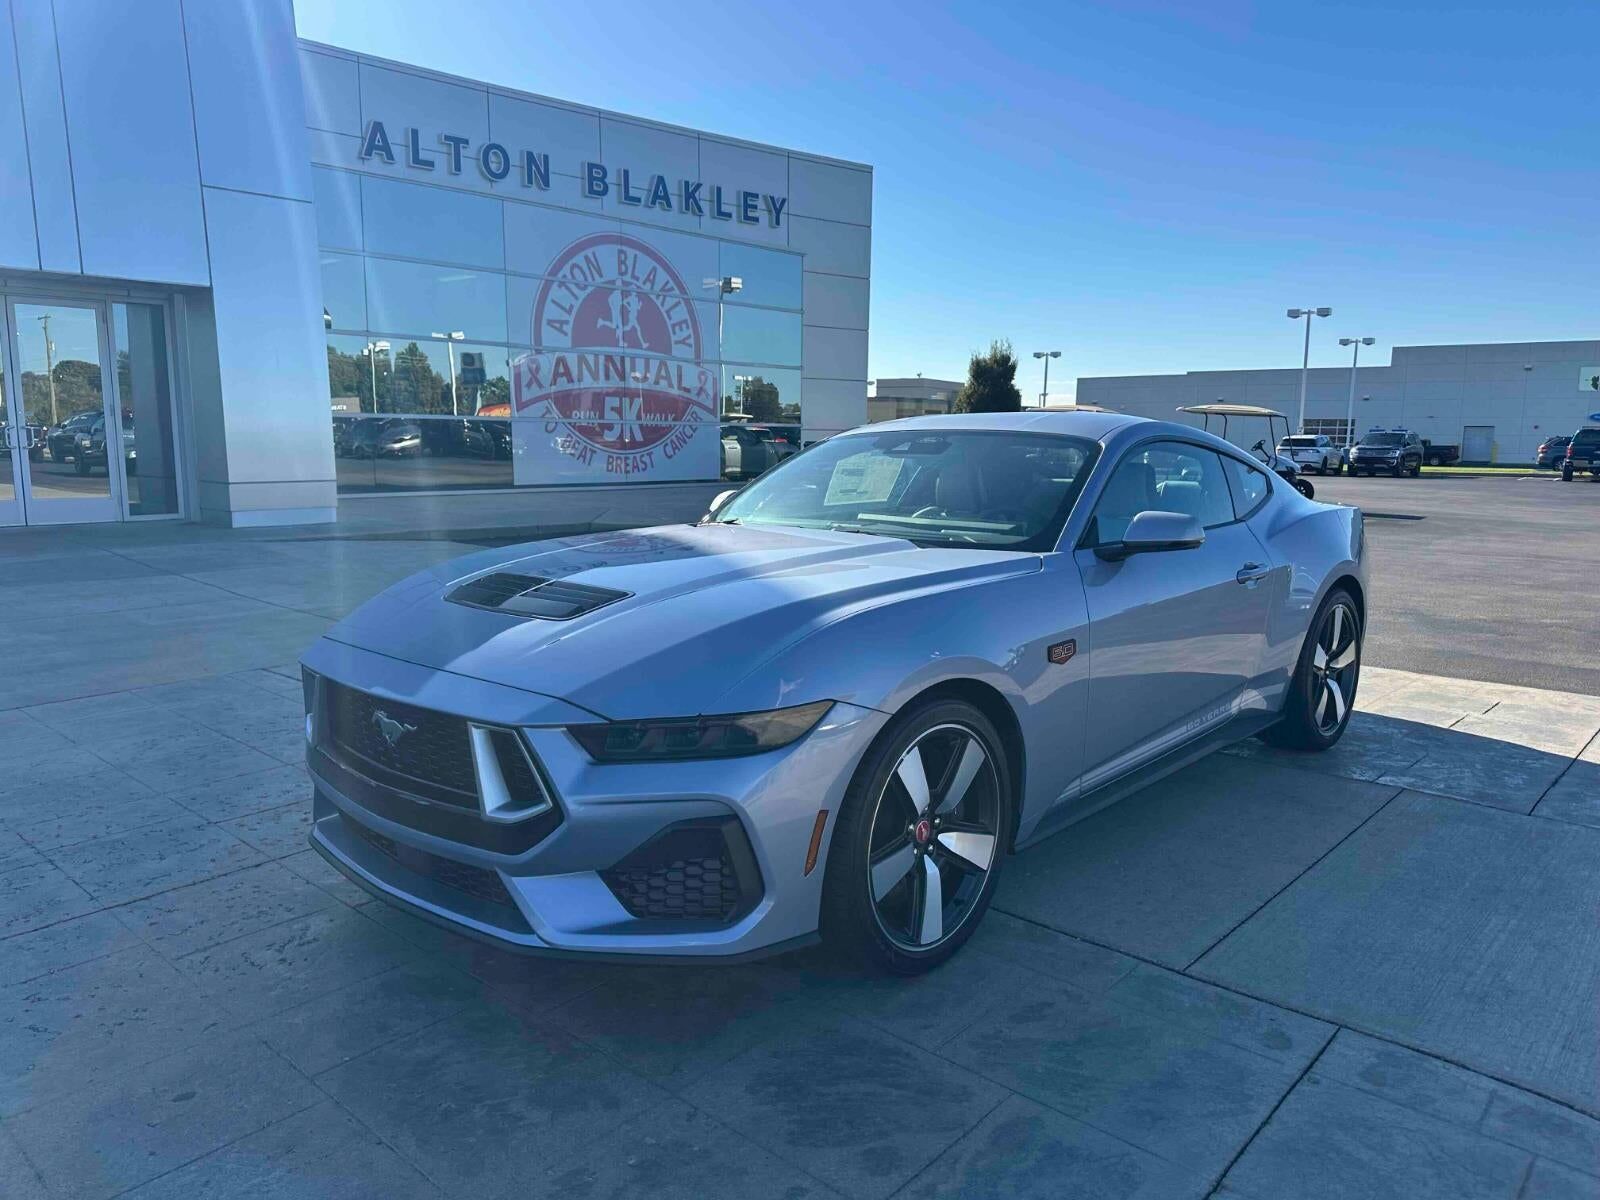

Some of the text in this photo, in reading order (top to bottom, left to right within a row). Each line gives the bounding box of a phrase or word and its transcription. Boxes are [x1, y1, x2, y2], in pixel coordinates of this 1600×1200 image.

[361, 120, 788, 227] ALTON BLAKLEY
[546, 248, 692, 351] ALTON BLAKLEY
[549, 354, 692, 394] ANNUAL
[542, 405, 703, 474] TO BEAT BREAST CANCER
[603, 396, 644, 442] 5K
